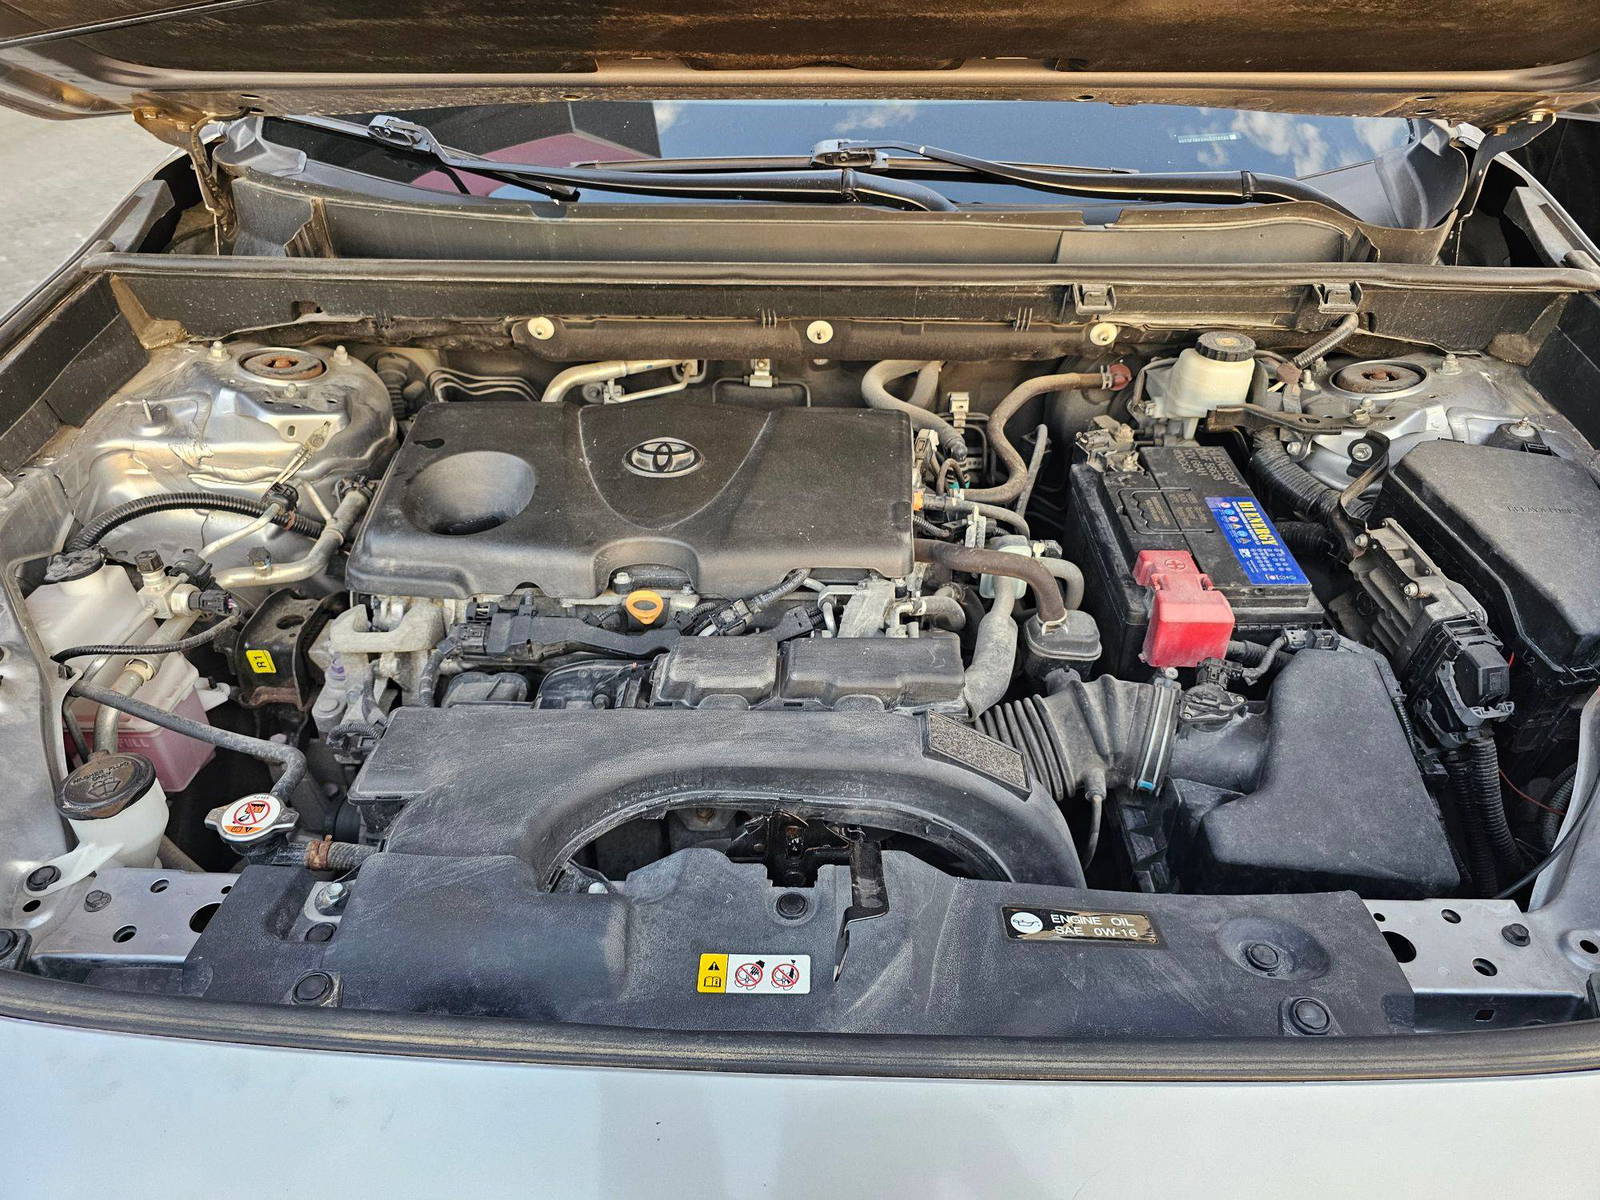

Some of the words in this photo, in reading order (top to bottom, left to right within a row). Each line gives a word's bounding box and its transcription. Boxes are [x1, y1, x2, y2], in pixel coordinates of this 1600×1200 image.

[1244, 513, 1278, 546] ENERGY
[254, 656, 267, 668] R1
[1050, 914, 1102, 925] ENGINE
[1111, 917, 1135, 927] OIL
[1054, 925, 1084, 936] SAE
[1093, 928, 1138, 938] 0W-16
